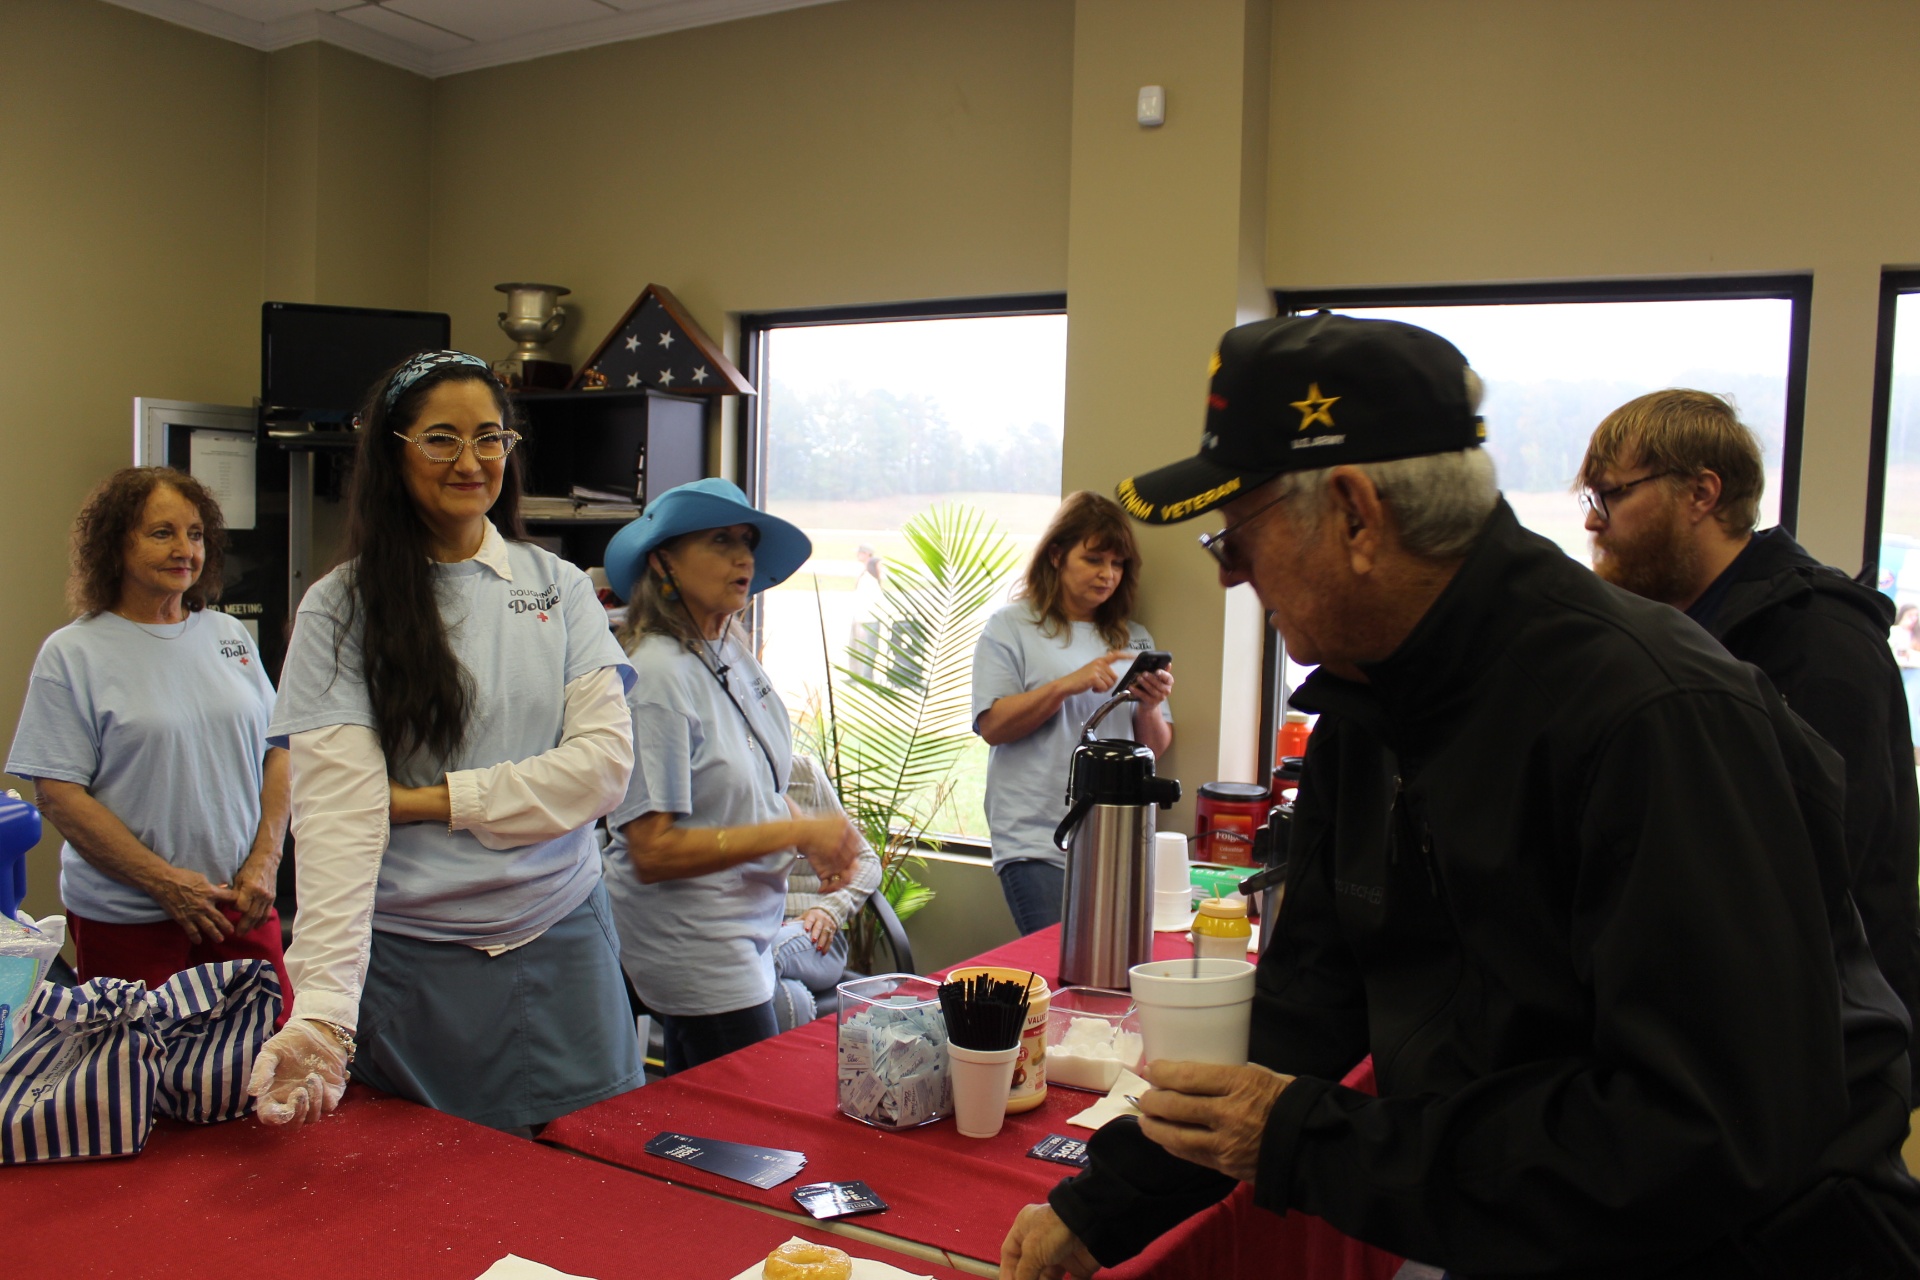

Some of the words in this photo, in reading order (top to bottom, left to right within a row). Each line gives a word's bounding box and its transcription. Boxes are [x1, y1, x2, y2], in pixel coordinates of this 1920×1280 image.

[1160, 477, 1241, 521] VETERAN
[509, 583, 557, 599] DOUGHNUT
[223, 603, 263, 614] MEETING
[1051, 1140, 1081, 1159] HOPE.
